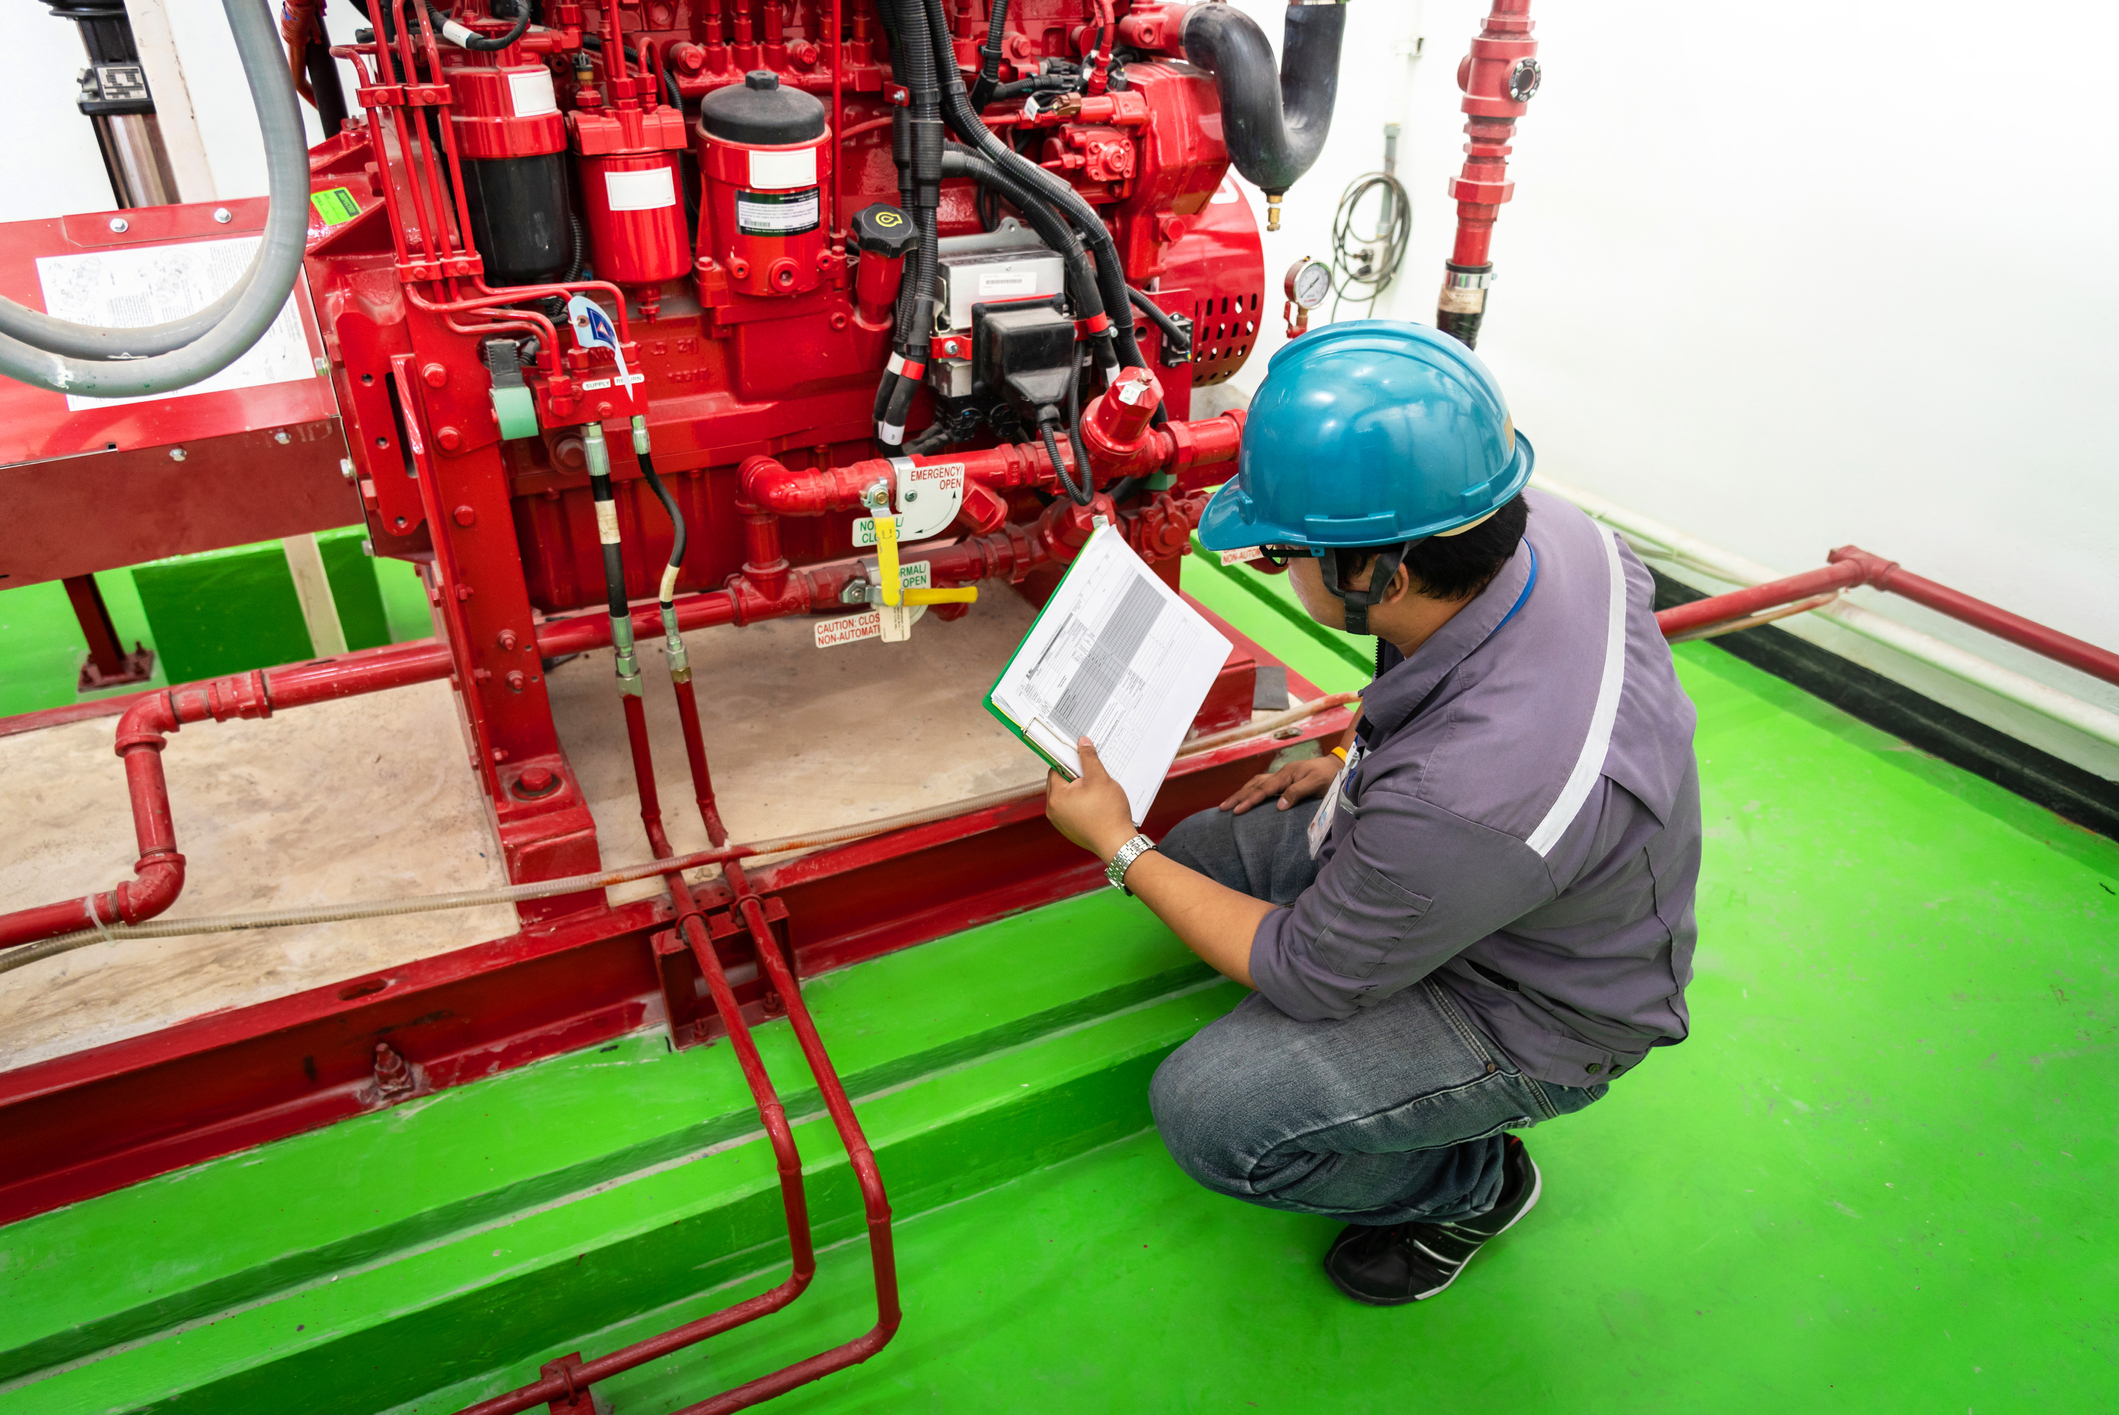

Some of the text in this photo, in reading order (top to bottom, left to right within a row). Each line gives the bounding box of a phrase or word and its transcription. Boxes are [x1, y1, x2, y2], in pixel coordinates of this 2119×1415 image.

[585, 380, 610, 390] SUPPLY
[616, 376, 642, 384] REURN
[910, 465, 963, 481] EMERGENCY/
[939, 477, 962, 490] OPEN
[859, 516, 905, 532] NOL/
[1222, 547, 1263, 564] NON-AUTOM
[900, 563, 927, 578] RMAL/
[902, 574, 927, 588] OPEN
[816, 618, 857, 635] CAUTION:
[858, 612, 881, 627] CLOS
[817, 623, 881, 647] NON-AUTOMATI
